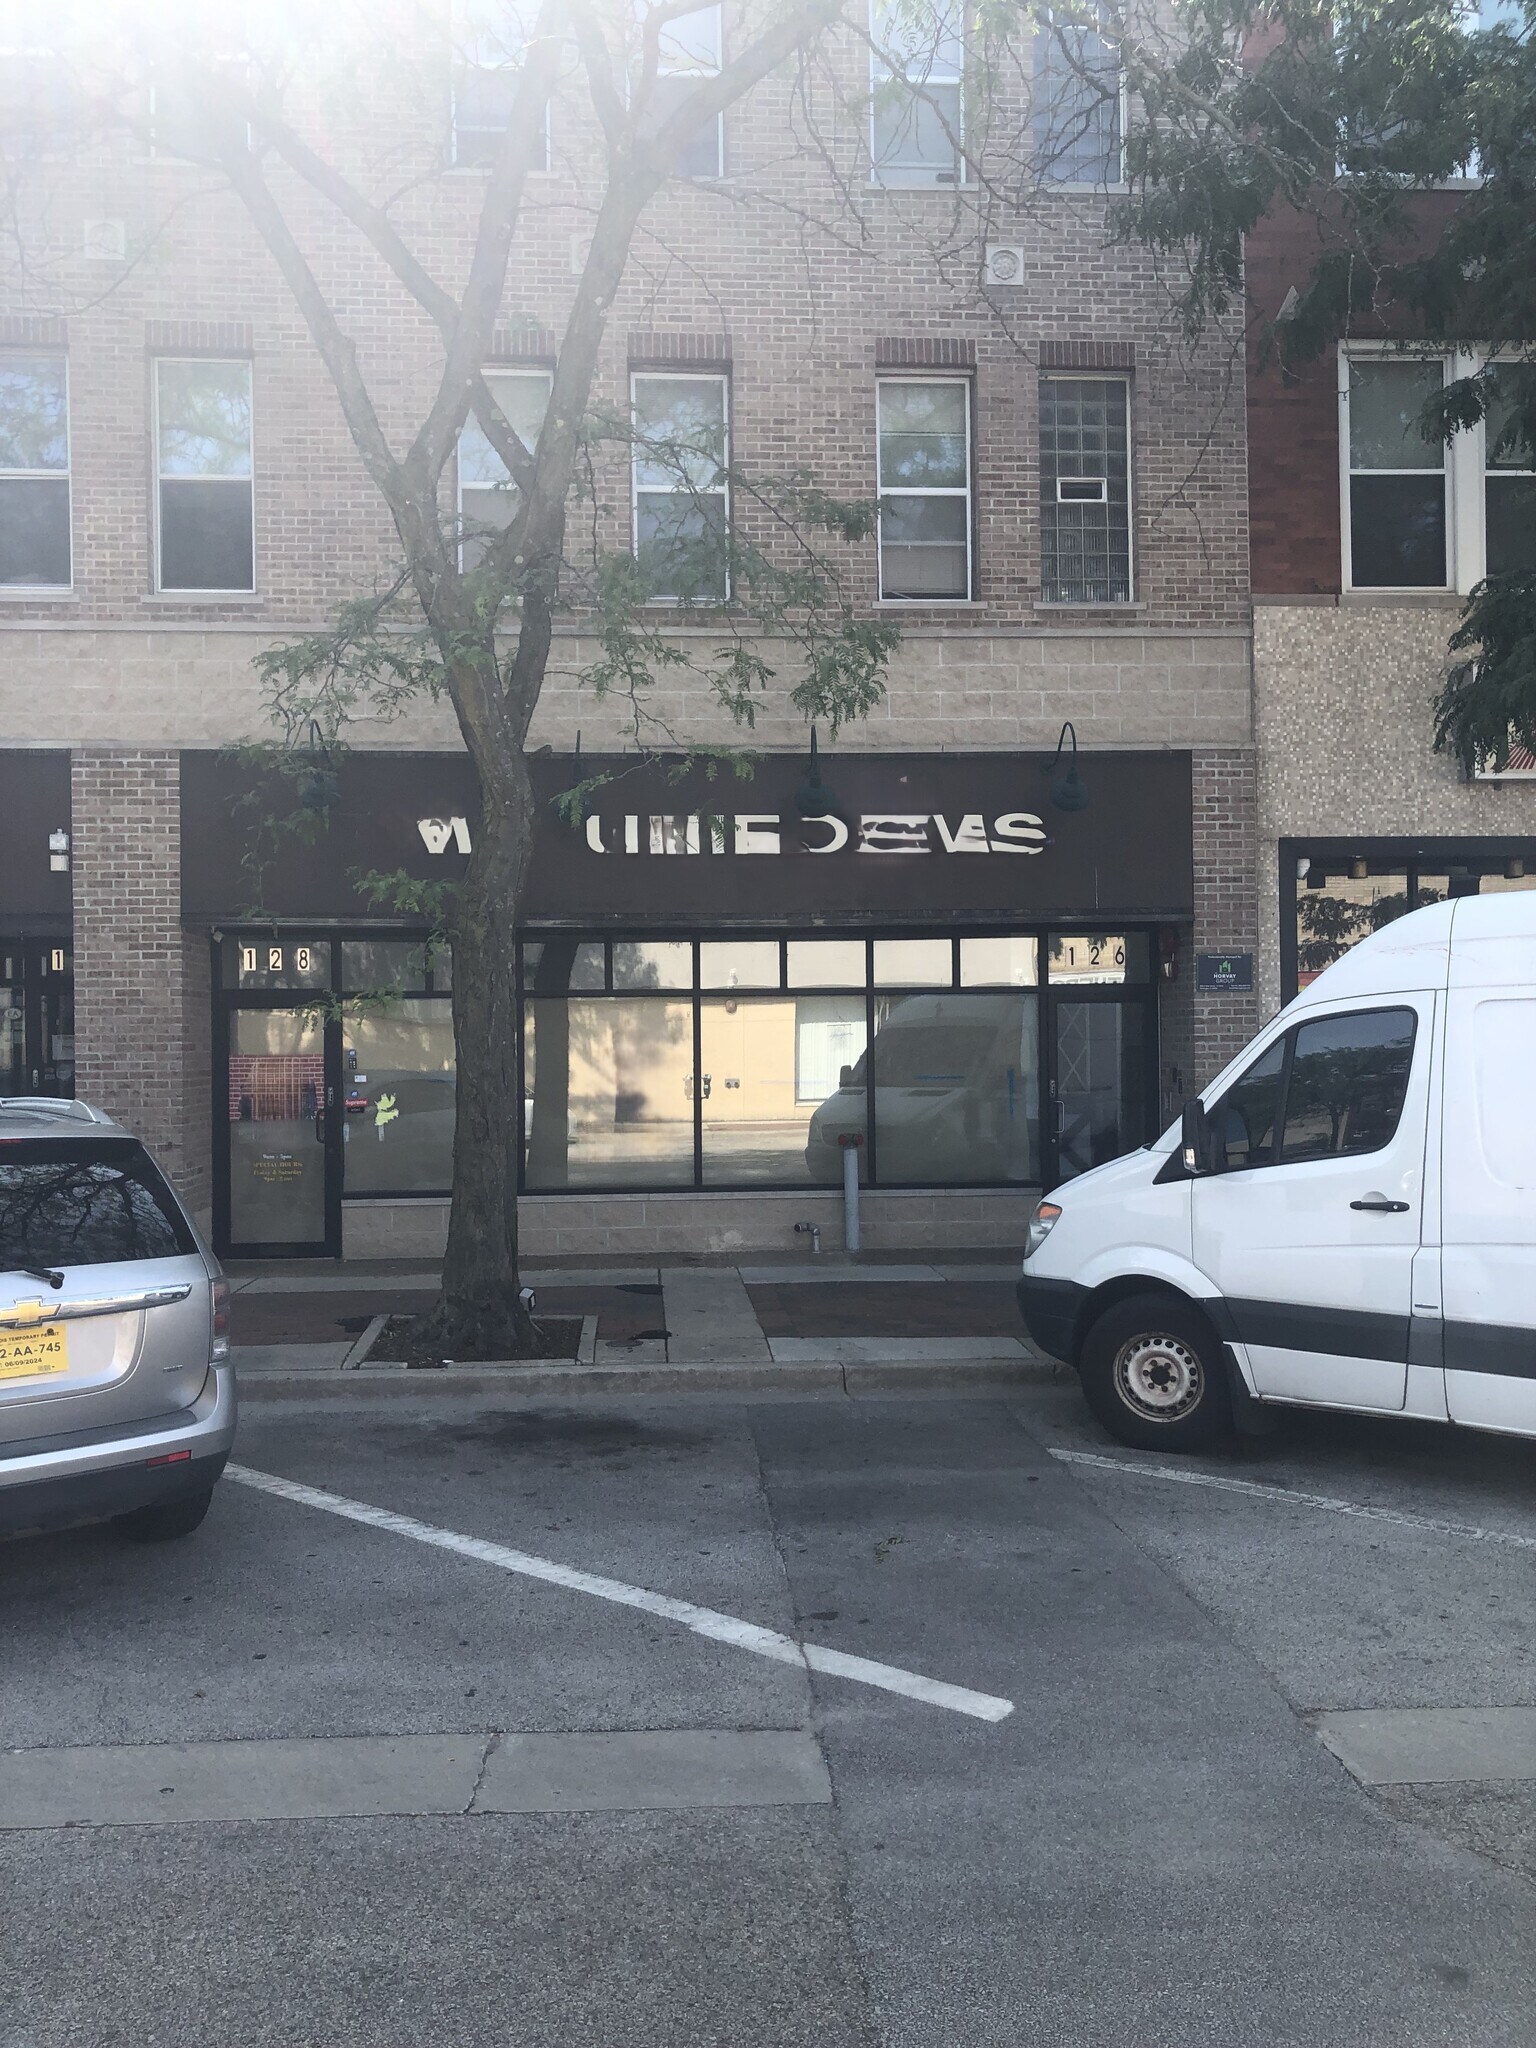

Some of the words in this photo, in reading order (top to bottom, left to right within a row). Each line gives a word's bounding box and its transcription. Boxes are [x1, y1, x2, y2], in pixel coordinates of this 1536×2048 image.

[247, 949, 308, 969] 128
[1068, 946, 1125, 966] 126
[0, 1342, 61, 1358] 2-AA-745
